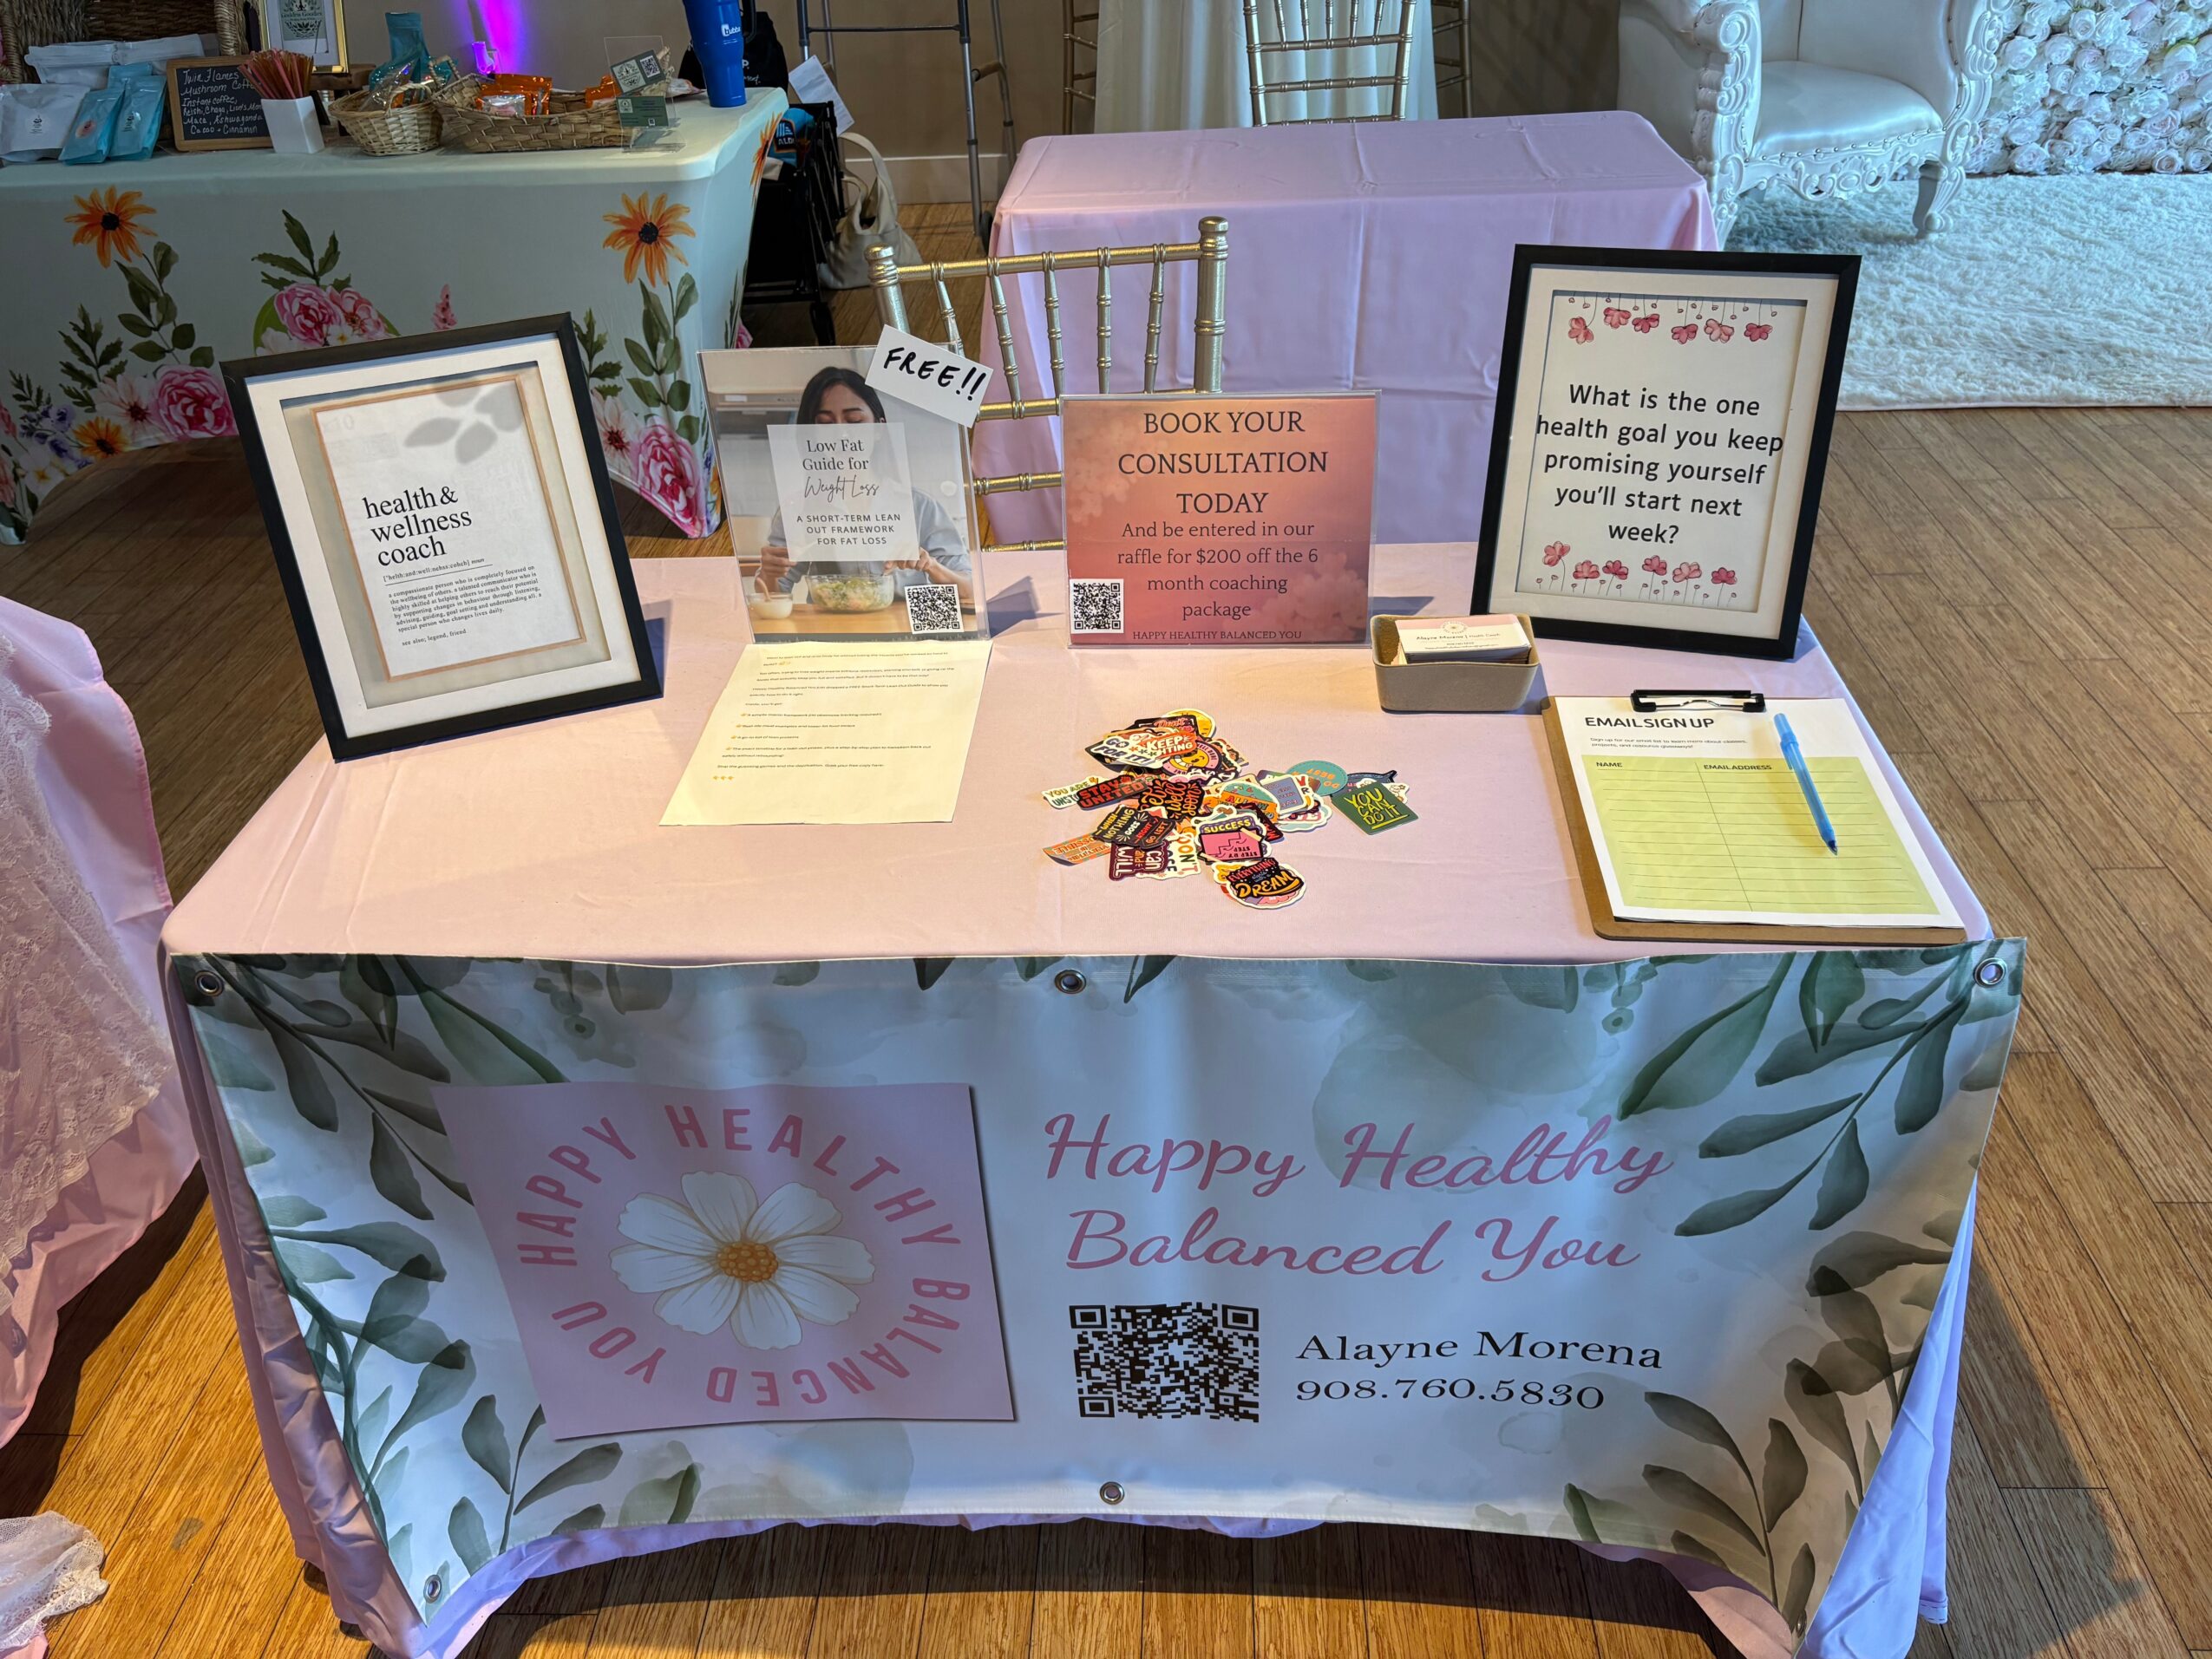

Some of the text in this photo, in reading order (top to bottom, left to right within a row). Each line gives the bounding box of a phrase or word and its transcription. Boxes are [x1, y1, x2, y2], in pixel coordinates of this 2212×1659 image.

[204, 68, 239, 82] Flames
[180, 84, 227, 97] Mushroom
[181, 97, 212, 107] Instant
[191, 124, 258, 134] Cacao Cinnamon
[883, 346, 987, 401] FREE!!
[1568, 384, 1760, 416] What is the one
[1144, 411, 1306, 434] BOOK YOUR
[806, 439, 864, 453] Low Fat
[1536, 415, 1784, 457] health goal you keep
[802, 456, 869, 471] Guide for
[1117, 451, 1329, 474] CONSULTATION
[1544, 453, 1768, 486] promising yourself
[805, 475, 879, 503] Weight Loss
[362, 486, 458, 519] health &
[1176, 493, 1269, 514] TODAY
[1554, 486, 1743, 518] you'll start next
[370, 511, 472, 543] wellness
[807, 513, 872, 523] SHORT-TERM
[875, 513, 901, 522] LEAN
[1122, 521, 1315, 538] And be entered in our
[807, 526, 894, 534] OUT FRAMEWORK
[817, 537, 836, 545] FOR
[841, 537, 858, 545] FAT
[1608, 522, 1679, 545] week?
[378, 534, 448, 566] coach
[1117, 548, 1319, 565] raffle for $200 off the 6
[394, 585, 434, 598] compassionate
[435, 581, 453, 591] person
[474, 571, 504, 585] completely
[506, 567, 527, 576] focused
[400, 593, 428, 604] wellbeing
[481, 576, 519, 587] communicator
[411, 599, 430, 608] skilled
[438, 594, 459, 604] helping
[515, 579, 539, 590] potential
[1147, 576, 1288, 595] month coaching
[402, 607, 432, 617] supporting
[434, 604, 455, 612] changes
[464, 596, 491, 605] behaviour
[492, 591, 514, 600] through
[489, 597, 528, 608] understanding
[1182, 602, 1252, 621] package
[398, 624, 418, 634] special
[418, 621, 438, 630] person
[451, 613, 474, 623] changes
[488, 607, 505, 616] daily.
[449, 628, 467, 637] friend
[1133, 630, 1302, 640] HAPPY HEALTHY BALANCED YOU
[1585, 716, 1714, 728] EMAIL SIGN UP
[1094, 746, 1127, 759] FOR
[1146, 735, 1183, 749] KEEP
[1161, 742, 1193, 754] HTING
[1044, 781, 1091, 798] YOU ARE
[1079, 780, 1120, 800] STAY
[1079, 782, 1145, 808] UNITED
[1343, 787, 1384, 808] YOU
[1357, 799, 1392, 819] CAN
[1362, 805, 1401, 826] DO IT
[1100, 813, 1118, 831] WHEN
[1103, 808, 1135, 839] NOTHING
[1124, 820, 1141, 836] GOES
[1136, 822, 1153, 839] RIGHT
[1145, 821, 1168, 844] GO LEFT
[1204, 819, 1251, 834] SUCCESS
[1176, 833, 1198, 872] DON'T
[1227, 858, 1277, 883] EVERYTHING
[1235, 871, 1294, 898] DREAM
[1044, 1114, 1675, 1199] Happy Healthy
[664, 1103, 961, 1246] HEALTHY
[516, 1116, 638, 1267] HAPPY
[1065, 1207, 1641, 1282] Balanced You
[550, 1301, 667, 1384] YOU
[704, 1277, 972, 1407] BALANCED
[1294, 1331, 1664, 1370] Alayne Morena
[1295, 1377, 1606, 1411] 908.760.5830
